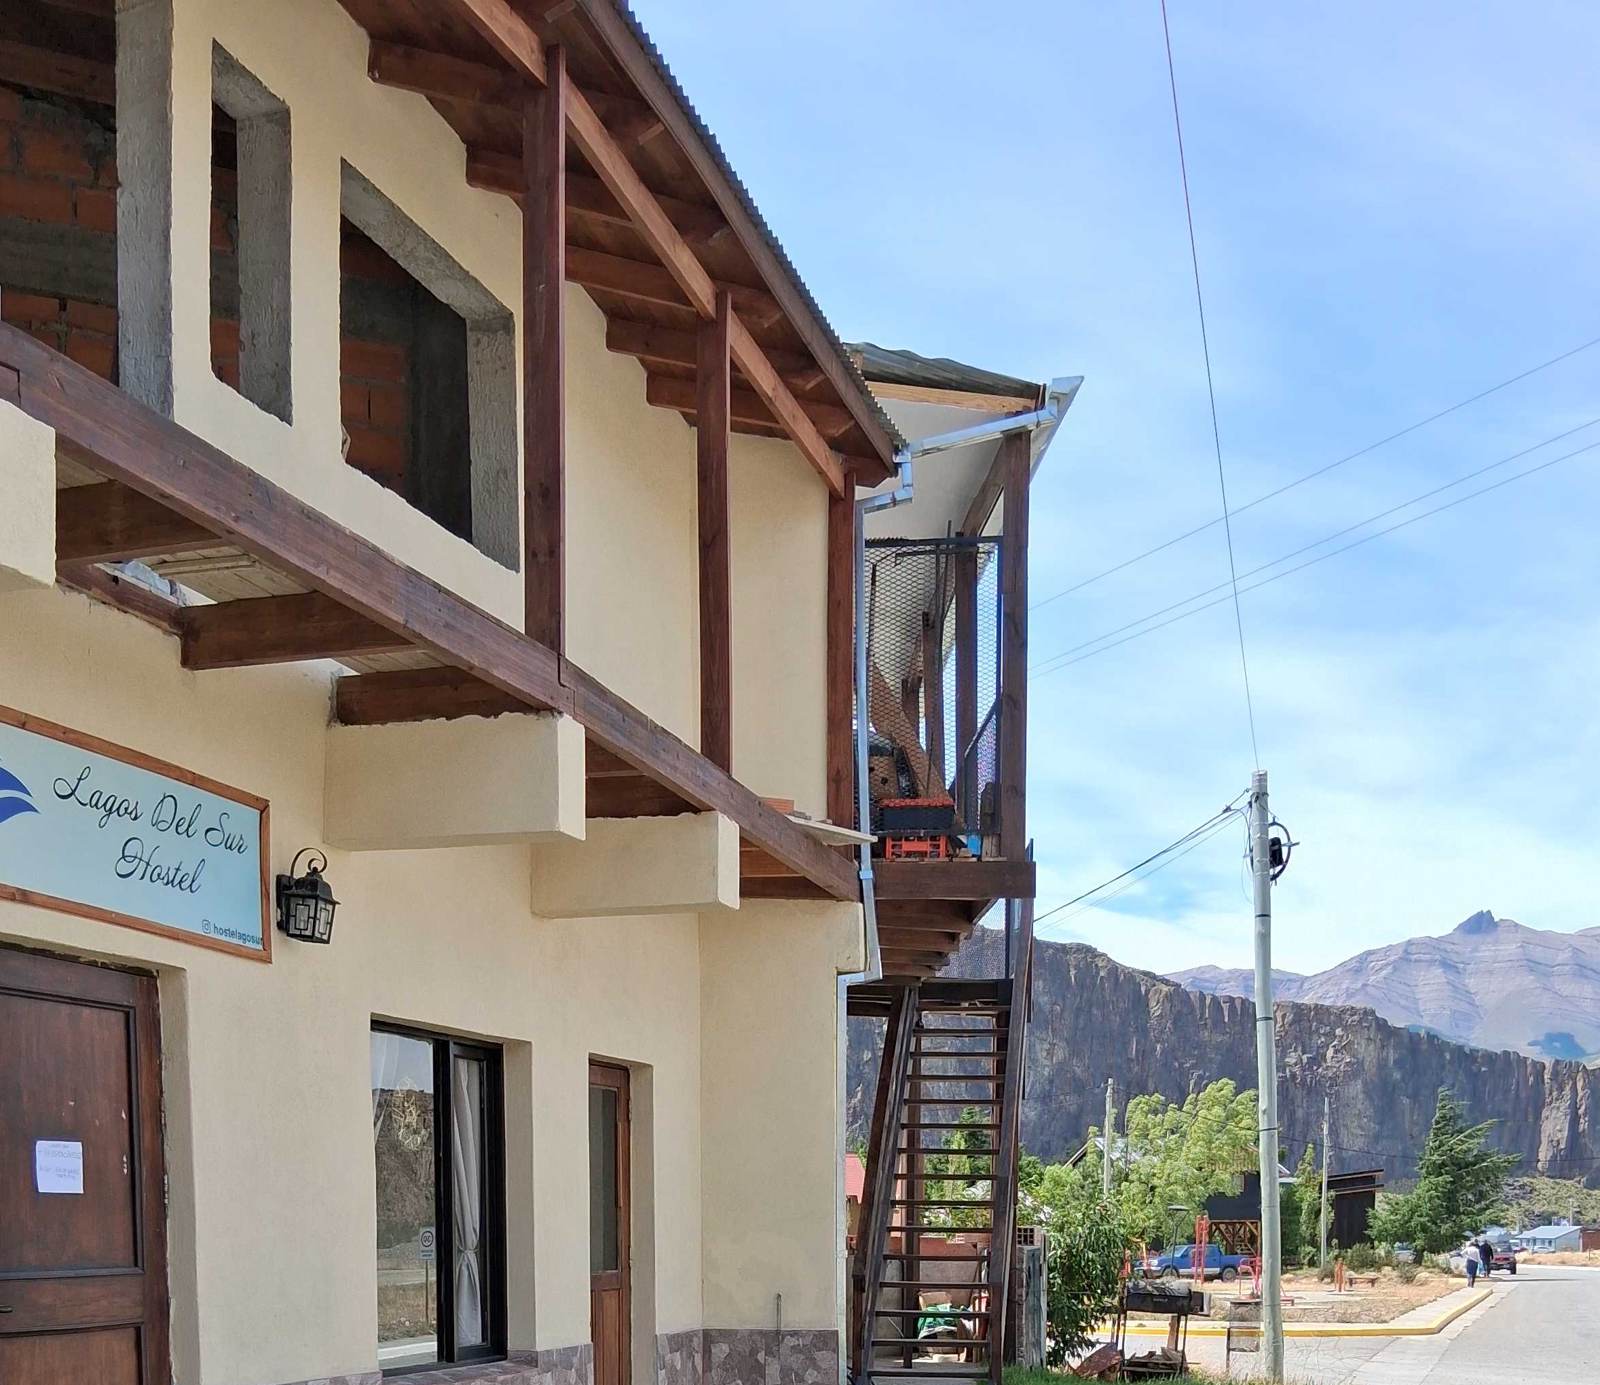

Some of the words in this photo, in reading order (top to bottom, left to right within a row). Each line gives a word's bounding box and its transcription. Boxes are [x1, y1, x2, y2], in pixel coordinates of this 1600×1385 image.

[53, 766, 143, 828] Lagos
[151, 793, 202, 838] Del
[204, 812, 248, 854] Sur
[114, 837, 206, 893] Hostel
